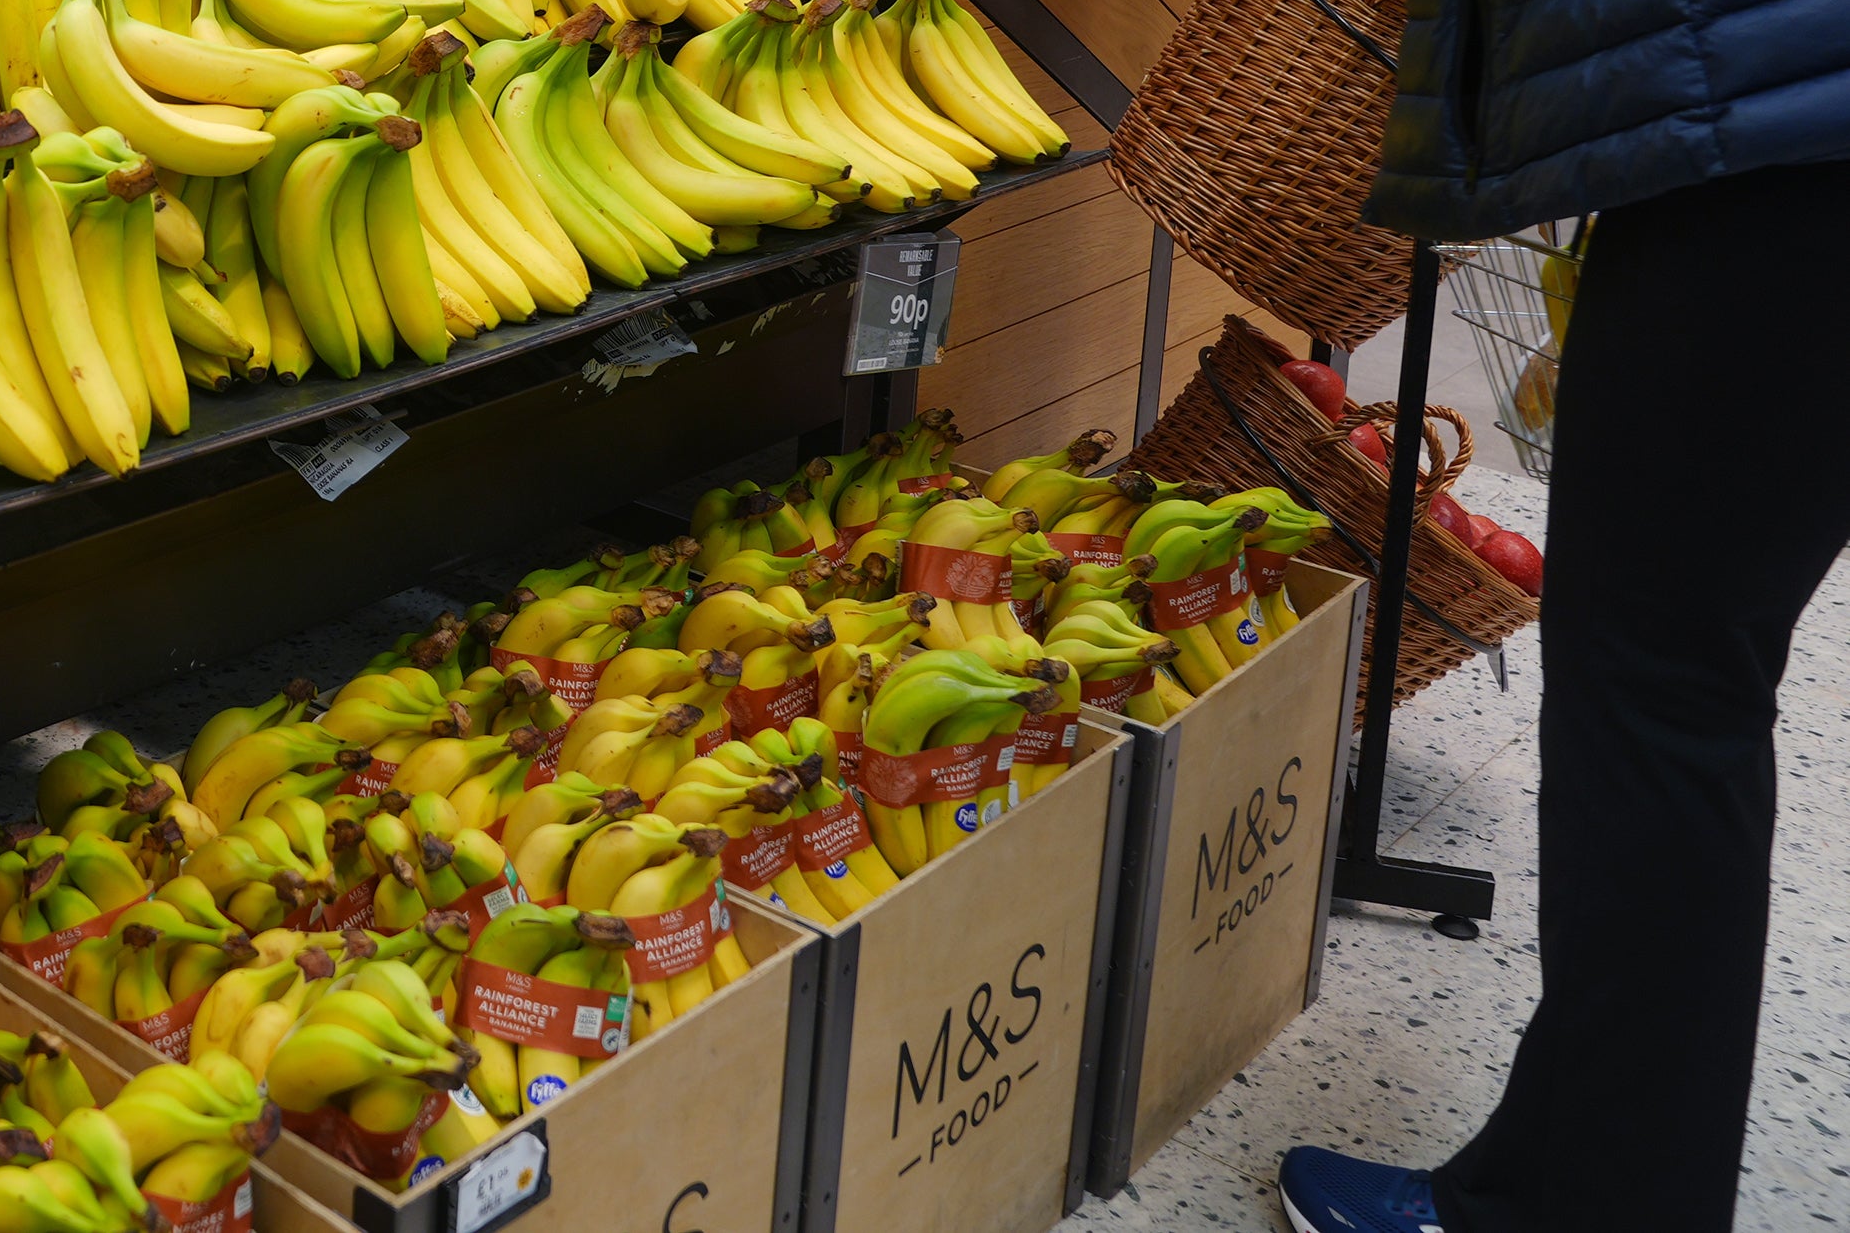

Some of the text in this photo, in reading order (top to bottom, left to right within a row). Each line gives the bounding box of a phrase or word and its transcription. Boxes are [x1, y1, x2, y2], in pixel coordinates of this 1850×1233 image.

[890, 294, 928, 330] 90p
[1073, 550, 1123, 561] RAINFOREST
[1168, 583, 1222, 607] RAINFOREST
[1177, 594, 1218, 616] ALLIANCE
[572, 663, 595, 674] M&S
[766, 680, 817, 712] RAINFOREST
[931, 755, 988, 778] RAINFOREST
[1191, 756, 1302, 919] M&S
[659, 909, 686, 925] M&S
[1215, 871, 1275, 945] FOOD
[634, 919, 705, 952] RAINFOREST
[646, 935, 703, 962] ALLIANCE
[505, 971, 532, 989] M&S
[474, 985, 558, 1018] RAINFOREST
[479, 1000, 546, 1028] ALLIANCE
[488, 1017, 532, 1035] BANANAS
[891, 943, 1047, 1139] M&S
[929, 1074, 1011, 1163] FOOD
